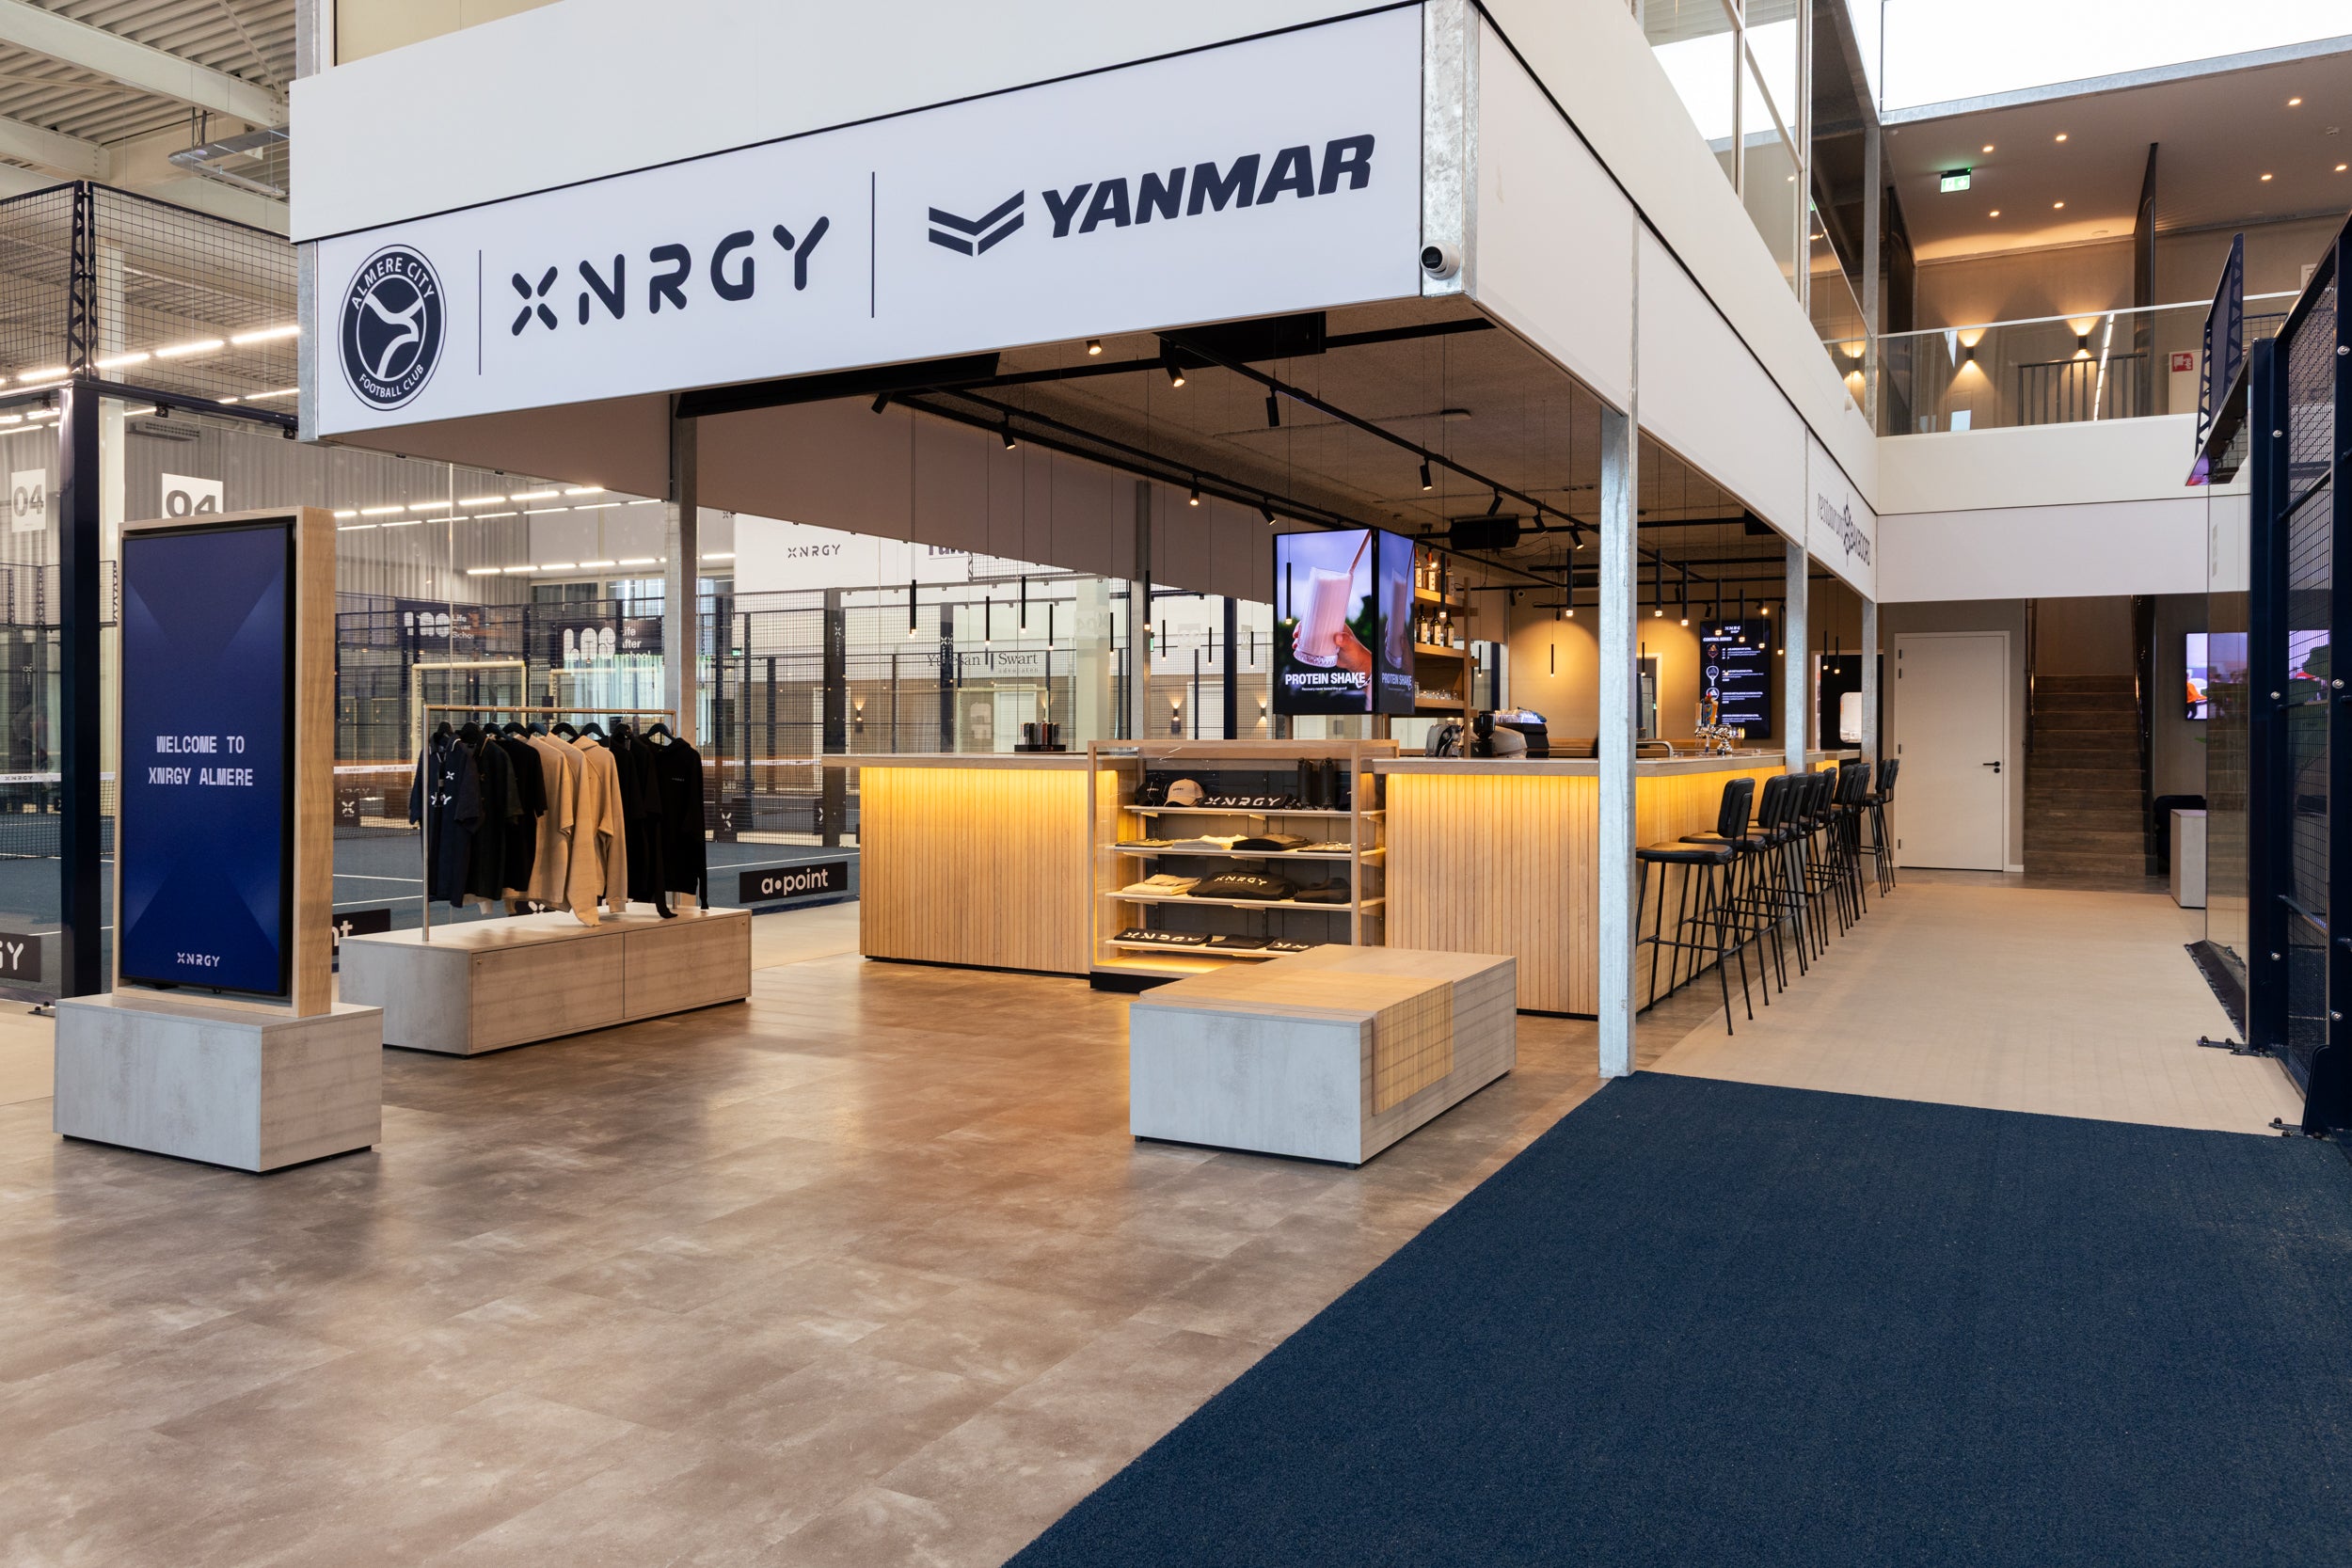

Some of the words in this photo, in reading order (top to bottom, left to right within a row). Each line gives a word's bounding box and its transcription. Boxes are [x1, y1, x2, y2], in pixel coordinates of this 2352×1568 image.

[1041, 134, 1375, 239] YANMAR
[351, 257, 404, 310] ALMERE
[406, 261, 435, 298] CITY
[511, 215, 831, 337] XNRGY
[358, 372, 403, 398] FOOTBALL
[403, 363, 424, 391] CLUB
[13, 484, 44, 517] 04
[166, 489, 220, 518] 04
[787, 544, 841, 559] XNRGY
[998, 652, 1039, 666] Swart
[1285, 673, 1328, 685] PROTEIN
[1330, 672, 1366, 686] SHAKE
[156, 736, 217, 753] WELCOME
[227, 736, 245, 753] TO
[148, 767, 192, 785] XNRGY
[199, 768, 254, 786] ALMERE
[1204, 797, 1280, 806] XNRGY
[177, 951, 220, 968] XNRGY
